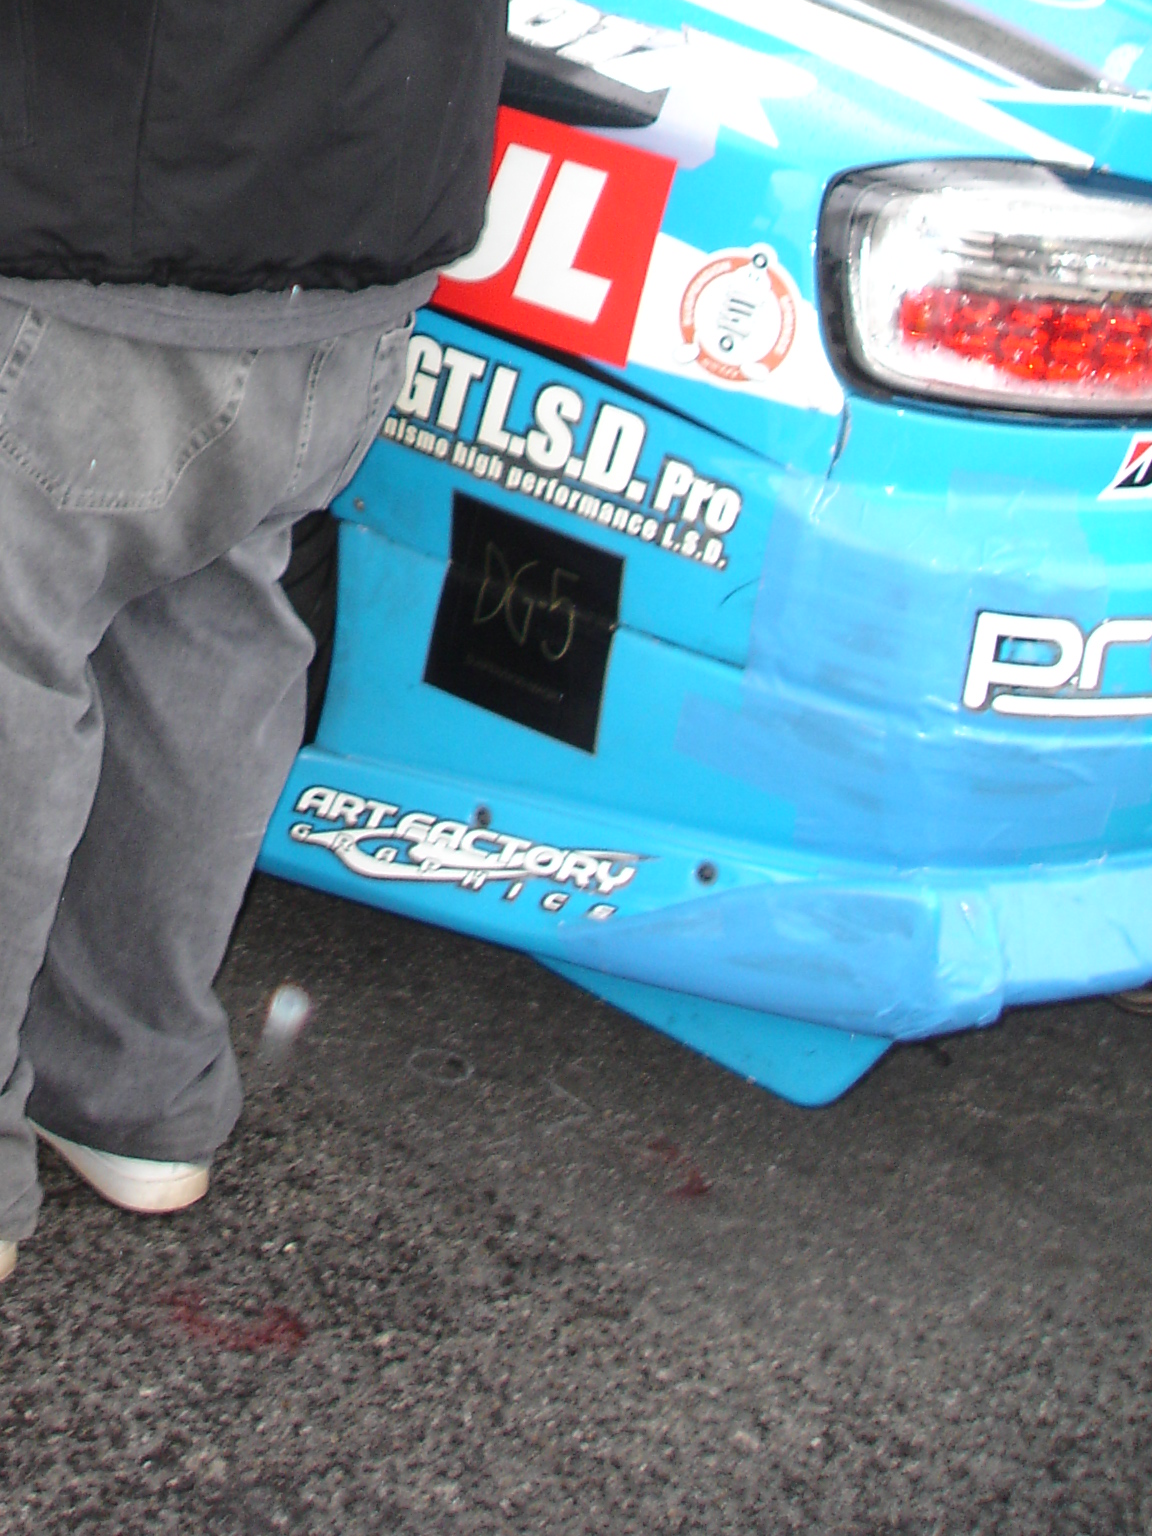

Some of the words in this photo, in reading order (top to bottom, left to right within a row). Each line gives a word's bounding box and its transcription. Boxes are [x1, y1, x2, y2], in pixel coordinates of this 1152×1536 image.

[382, 415, 448, 459] nismo
[451, 438, 504, 480] high
[504, 465, 658, 541] performance
[653, 458, 743, 535] Pro
[294, 785, 398, 829] ART
[395, 811, 636, 895] FACTORY
